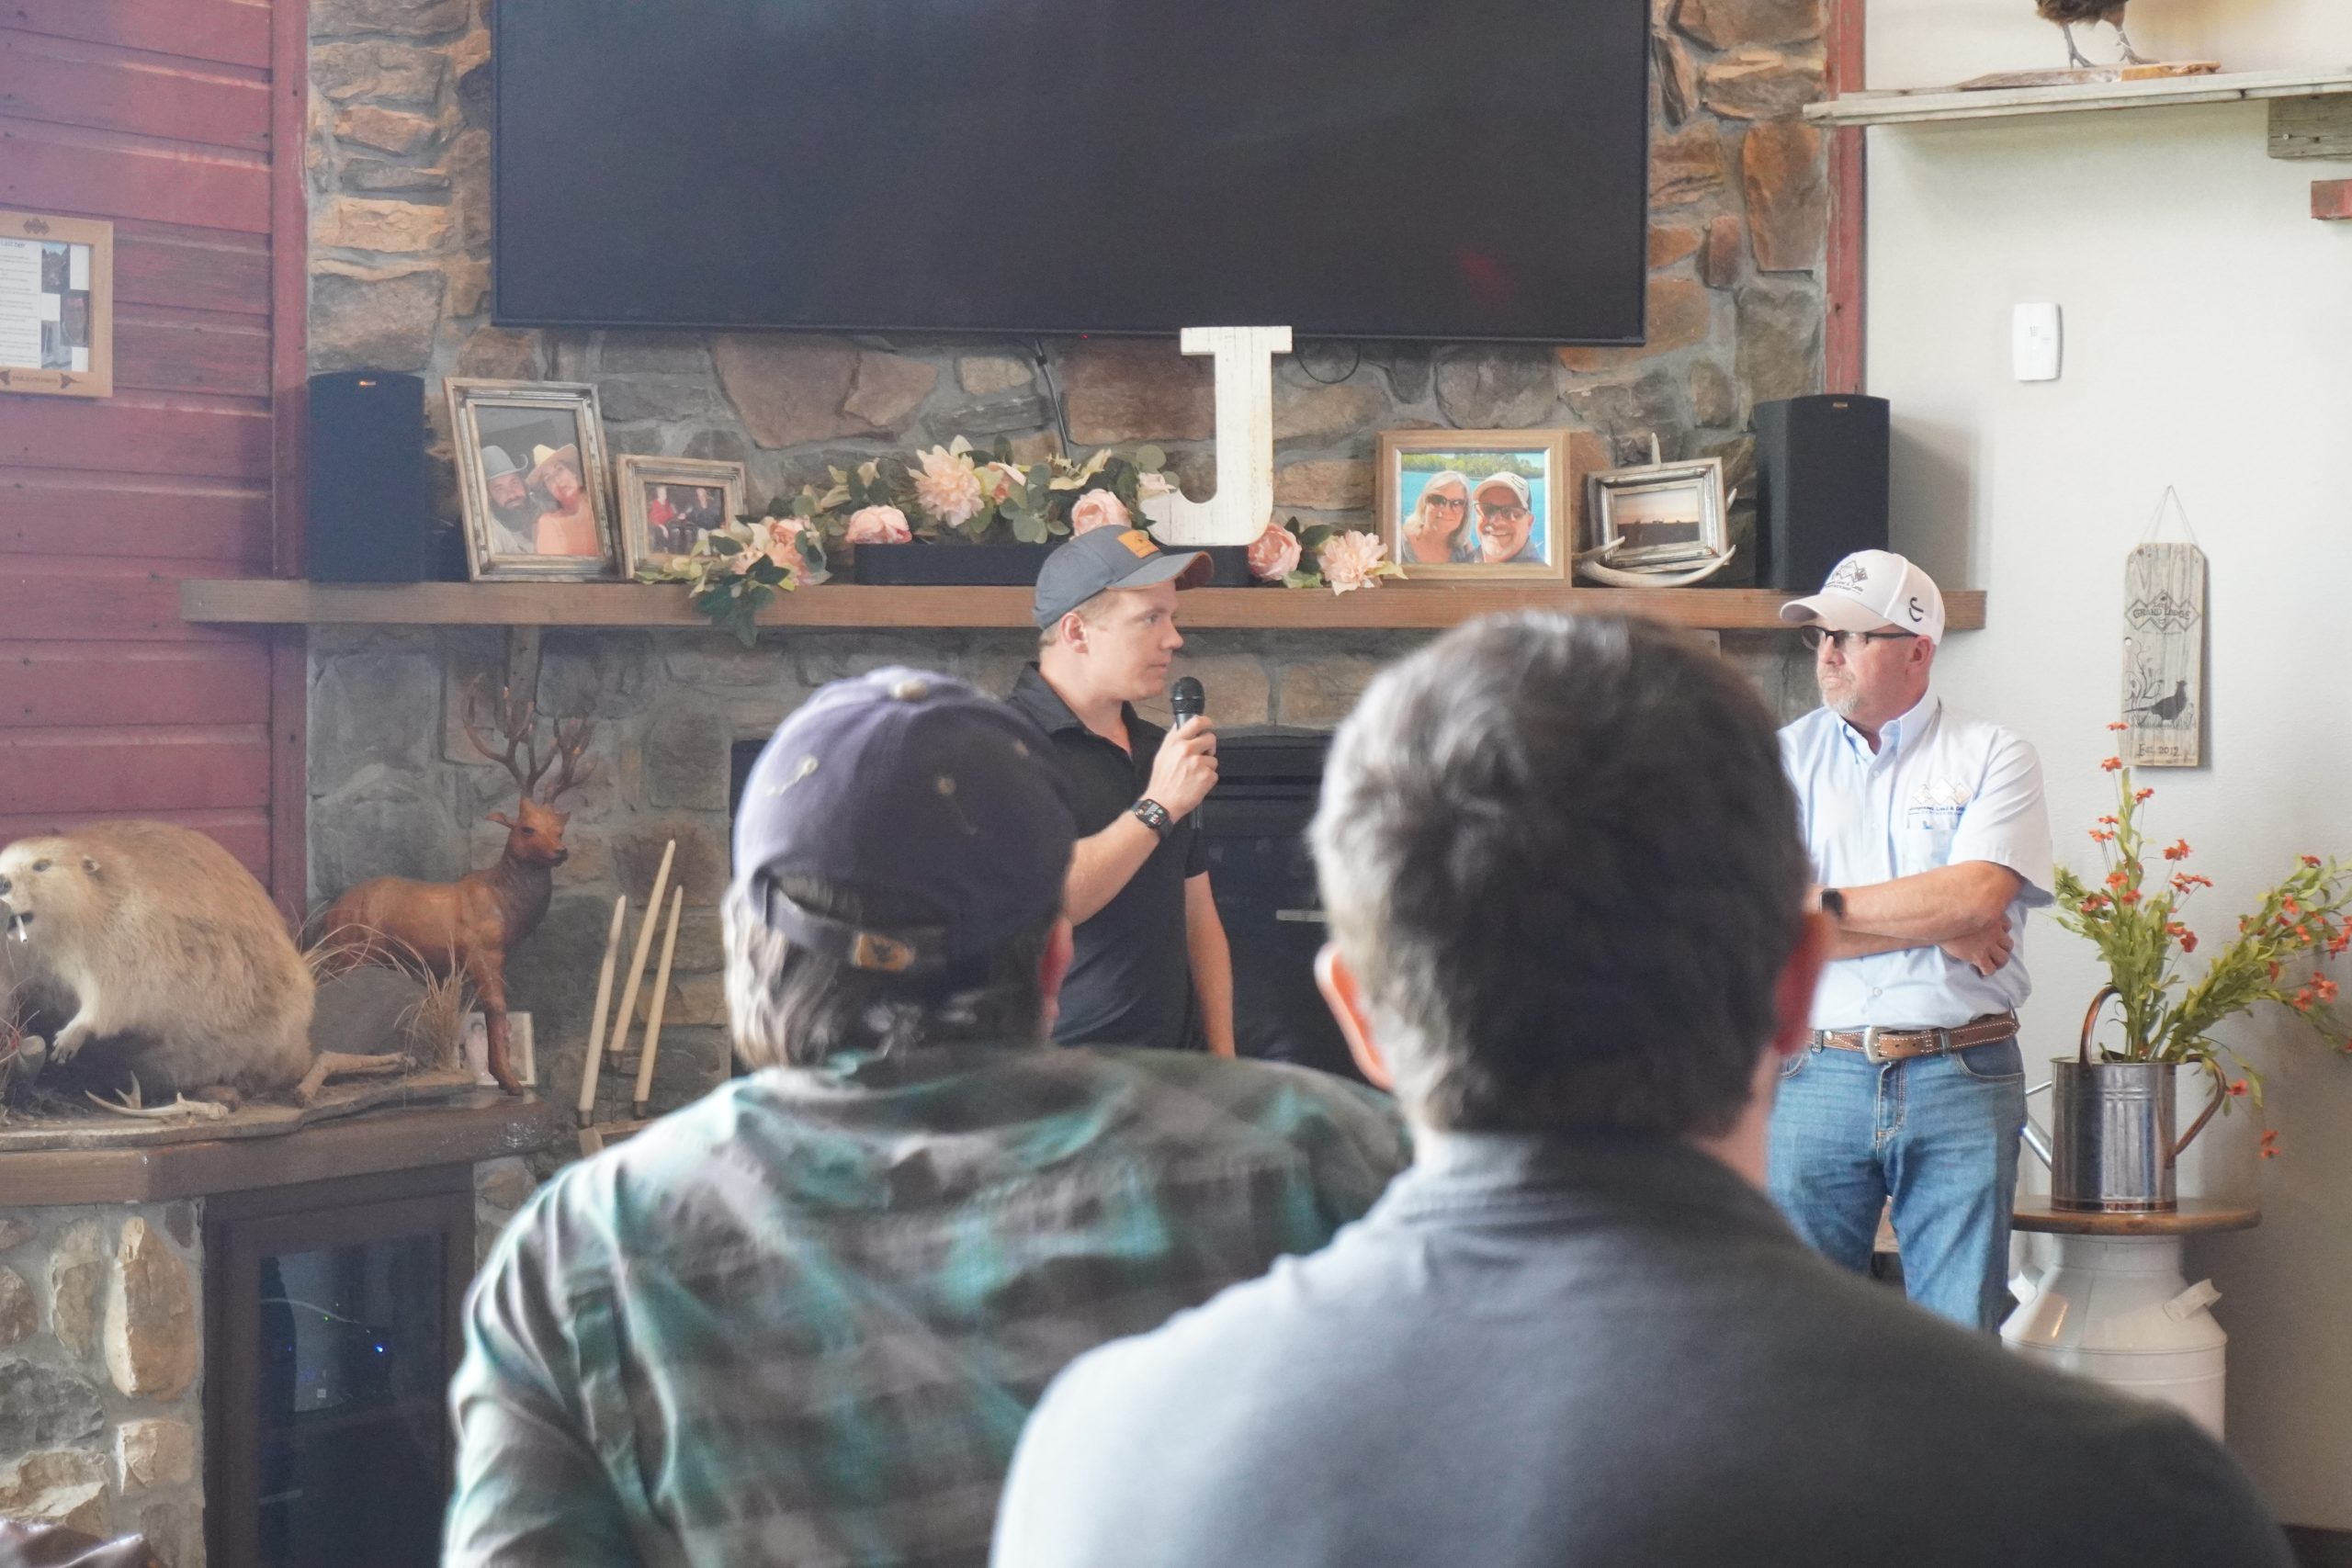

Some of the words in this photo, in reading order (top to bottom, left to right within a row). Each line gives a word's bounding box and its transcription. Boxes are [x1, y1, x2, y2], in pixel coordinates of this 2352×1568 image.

[1139, 326, 1293, 547] J
[2132, 608, 2163, 619] GRAND
[2165, 608, 2191, 620] LODGE
[2158, 746, 2180, 757] 2012
